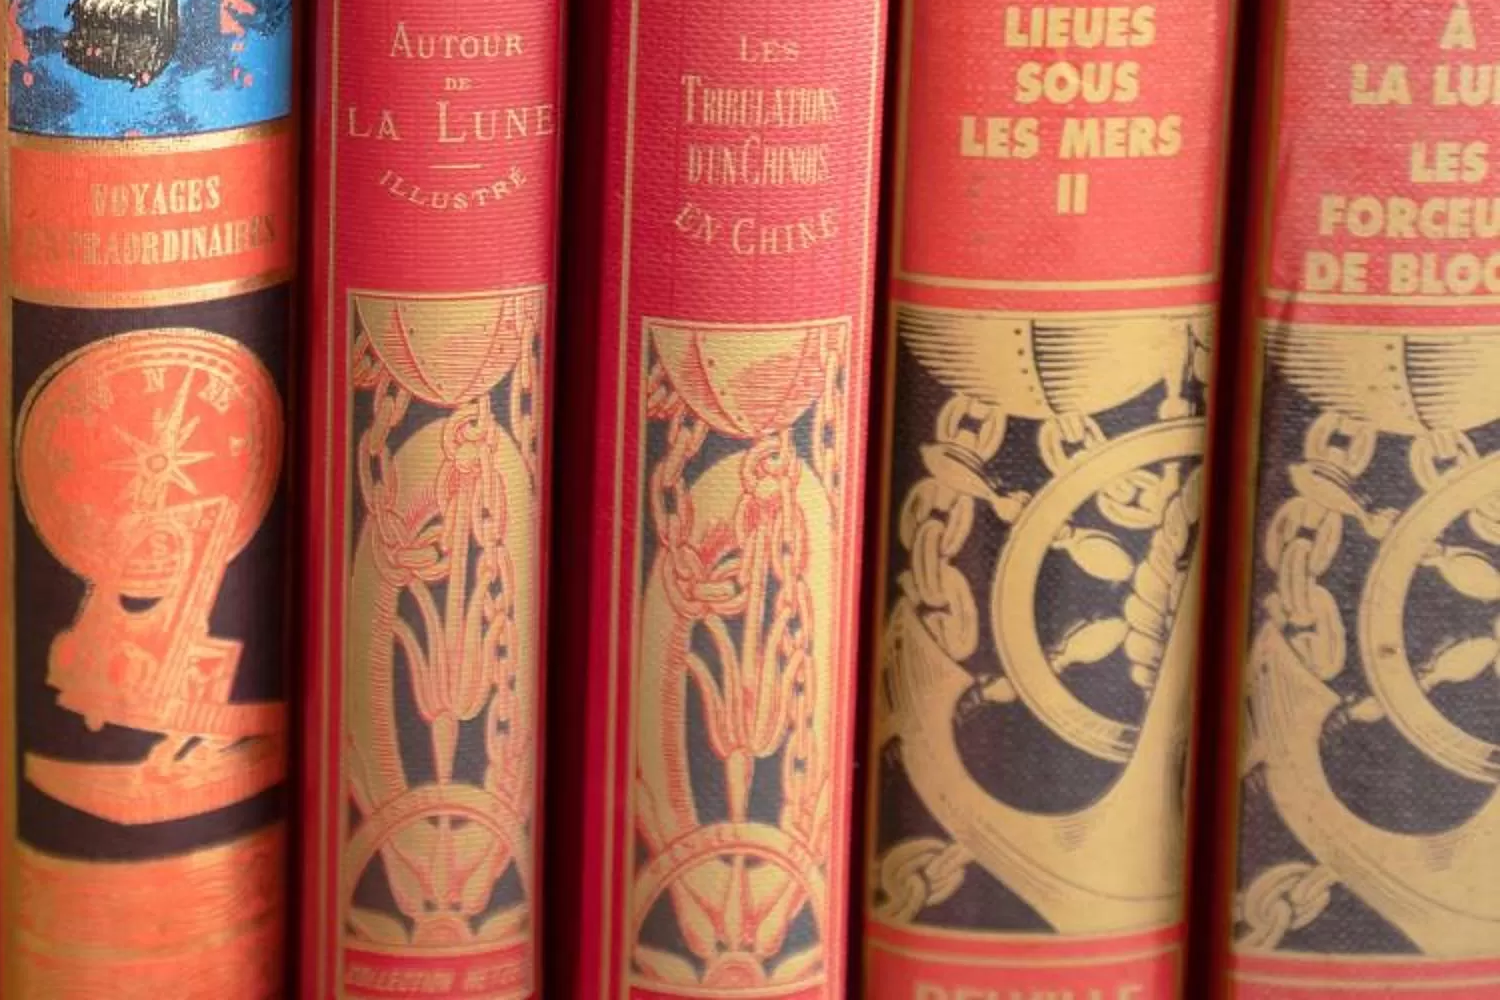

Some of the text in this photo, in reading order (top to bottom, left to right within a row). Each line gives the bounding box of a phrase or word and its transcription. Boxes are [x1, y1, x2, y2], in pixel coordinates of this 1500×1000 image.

[389, 20, 525, 60] AUTOUR
[739, 34, 800, 63] LES
[1004, 5, 1157, 49] LIEUES
[443, 76, 474, 91] DE
[1014, 60, 1142, 105] SOUS
[1349, 63, 1500, 107] LA LU
[348, 100, 555, 143] LA LUNE
[959, 115, 1184, 160] LES MERS
[1410, 140, 1490, 184] LES
[90, 174, 222, 218] VOYAGES
[379, 164, 528, 210] ILLUSTRÉ
[1055, 173, 1089, 215] II
[731, 206, 840, 255] CHINE
[1304, 250, 1367, 293] DE
